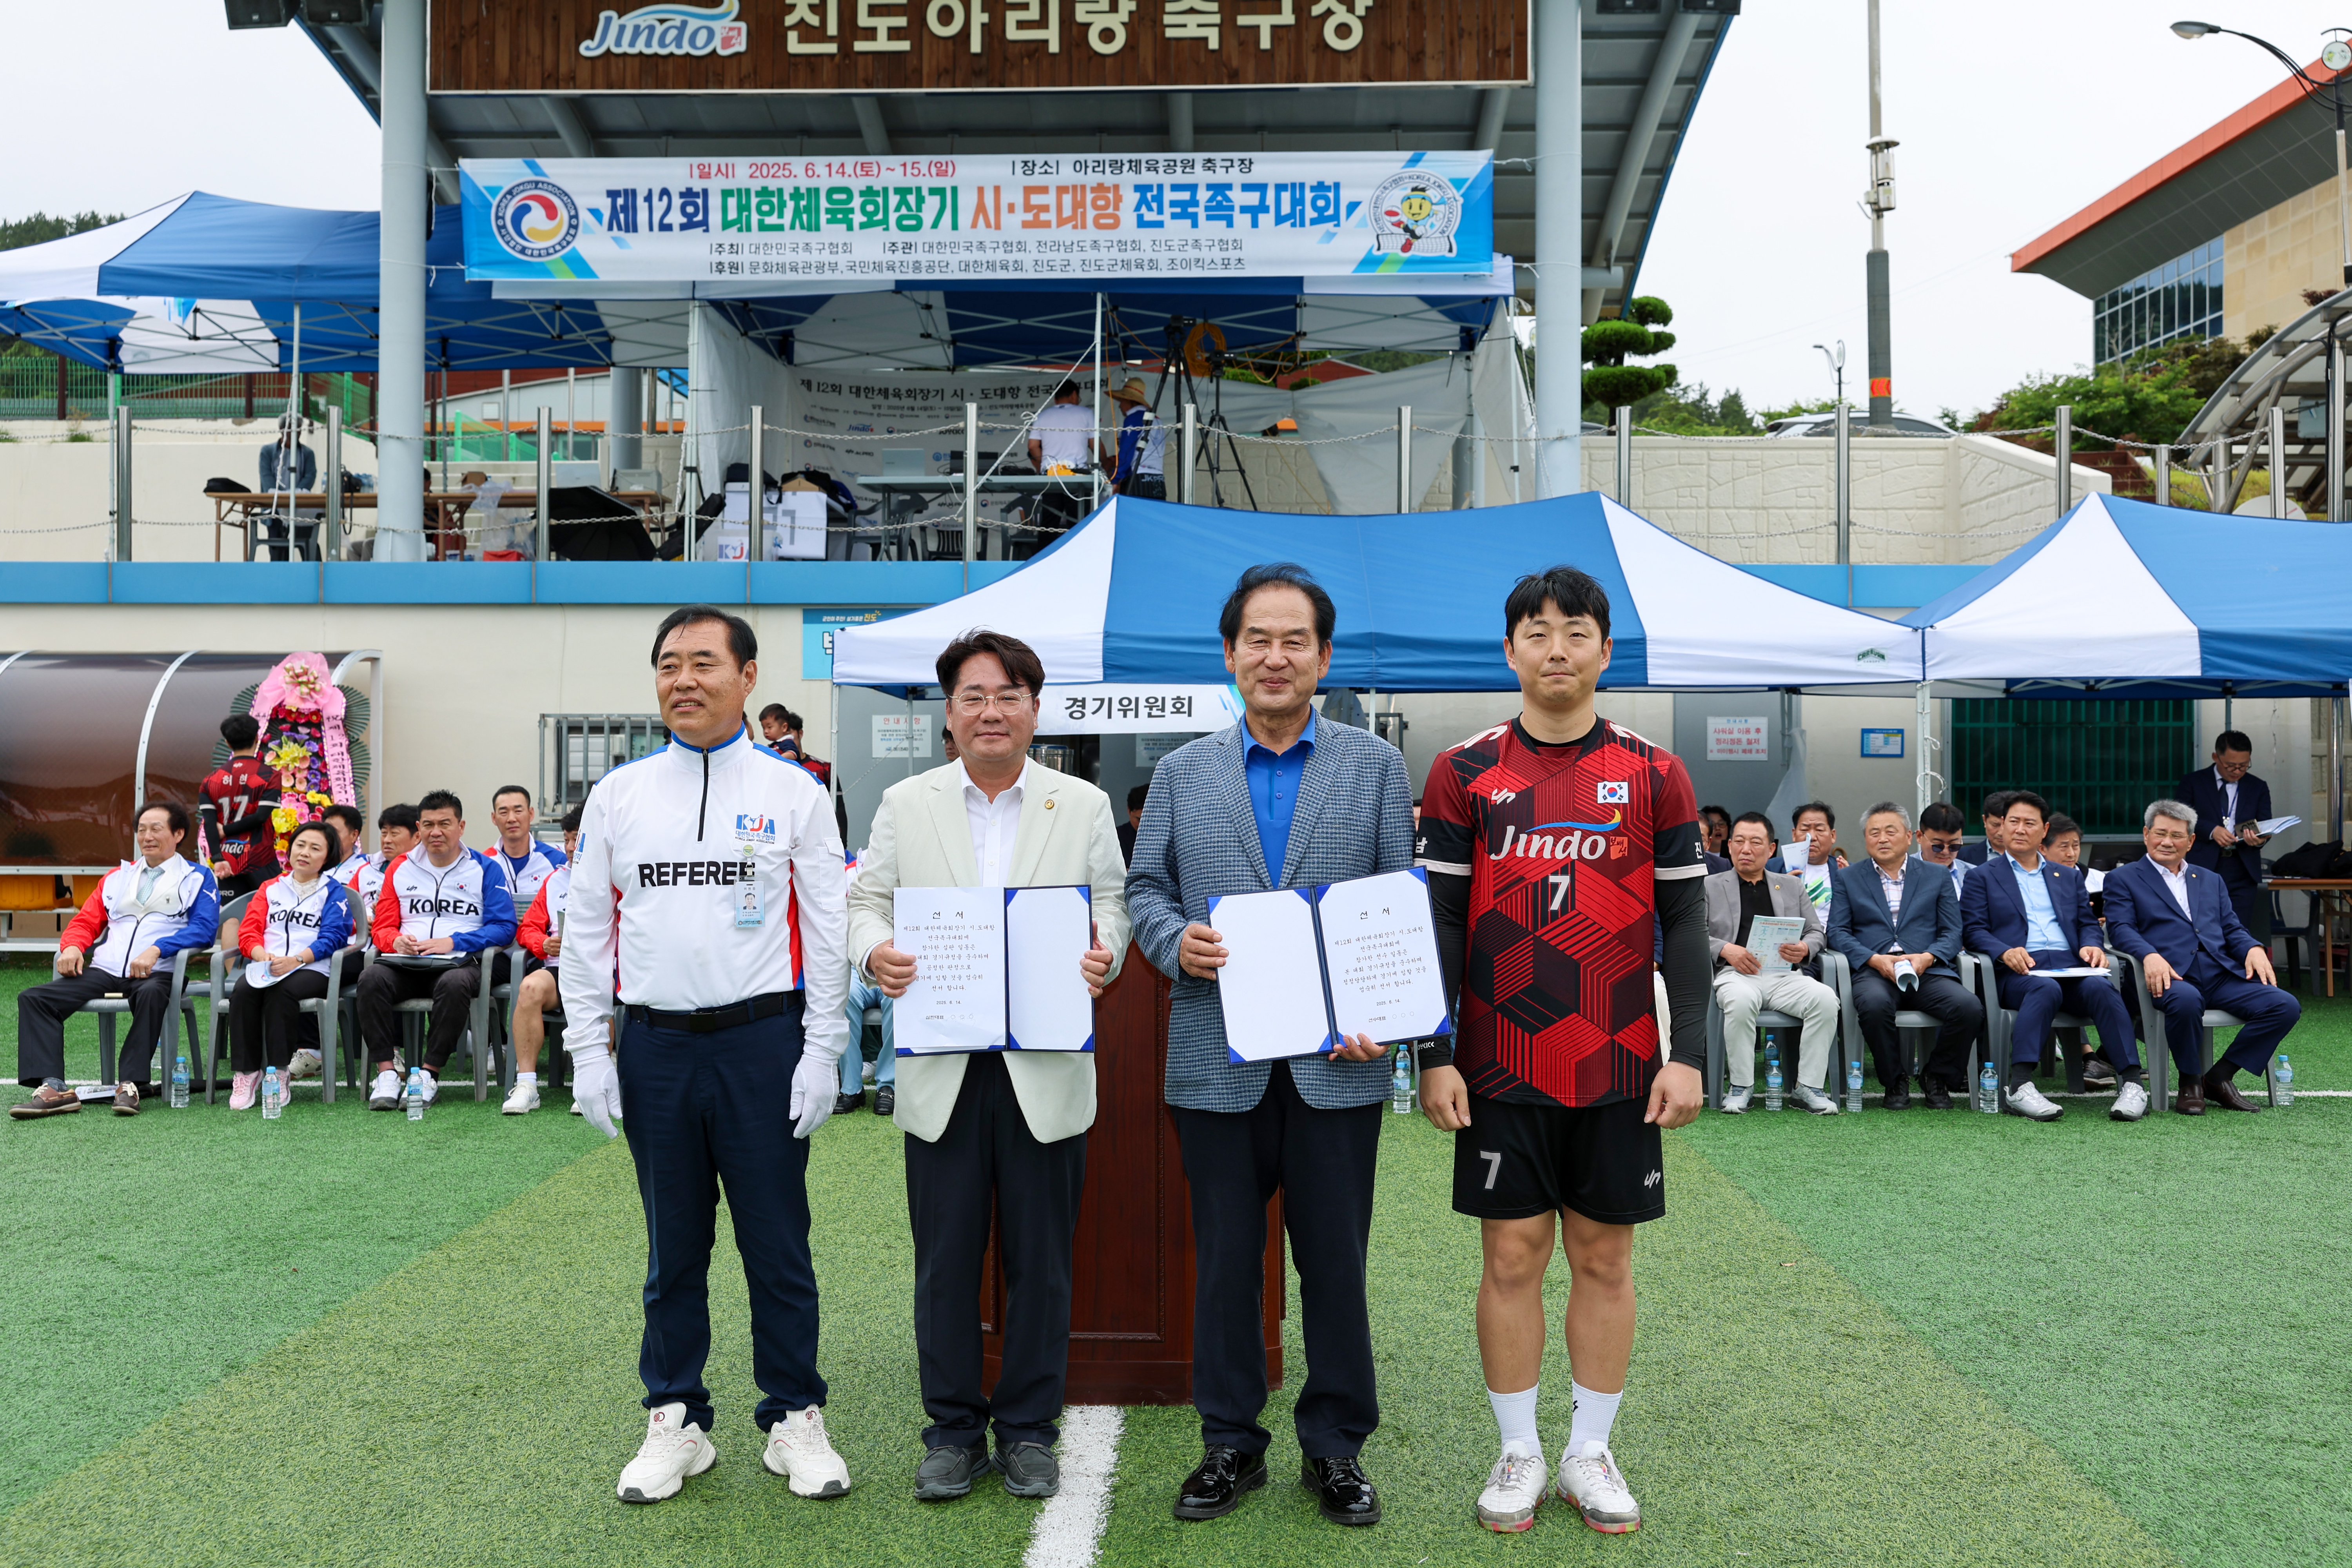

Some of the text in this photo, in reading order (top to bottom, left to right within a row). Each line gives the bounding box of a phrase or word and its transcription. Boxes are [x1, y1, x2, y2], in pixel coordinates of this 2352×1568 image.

[584, 15, 716, 51] Jindo
[785, 0, 1372, 54] 진도아리랑 축구장
[749, 162, 797, 178] 2025.
[1073, 158, 1196, 175] 아리랑체육공원
[1201, 158, 1254, 173] 축구장
[497, 182, 576, 217] KOREA JOKGU ASSOCIATION
[606, 181, 1341, 232] 제12회 대한체육회장기 시·도대항 전국족구대회
[749, 242, 853, 255] 대한민국족구협회
[923, 240, 1031, 254] 대한민국족구협회,
[1036, 240, 1145, 253] 전라남도족구협회,
[1151, 239, 1242, 252] 진도군족구협회
[749, 261, 843, 274] 문화체육관광부,
[846, 260, 953, 274] 국민체육진흥공단,
[959, 259, 1027, 273] 대한체육회,
[1032, 259, 1075, 273] 진도군,
[1080, 258, 1162, 272] 진도군체육회,
[1167, 257, 1245, 271] 조이킥스포츠
[800, 379, 812, 392] 제
[817, 382, 842, 396] 12회
[849, 385, 944, 401] 대한체육회장기
[719, 543, 749, 559] KJ
[864, 613, 877, 622] 진도
[1857, 649, 1885, 661] CARAVAN
[1064, 695, 1192, 720] 경기위원회
[218, 795, 249, 826] 17
[735, 830, 775, 842] 대한민국족구협회
[1490, 826, 1606, 860] Jindo
[1416, 837, 1428, 853] 남
[638, 861, 755, 887] REFEREE
[1549, 875, 1570, 911] 7
[409, 898, 479, 916] KOREA
[269, 910, 322, 928] KOREA
[1334, 938, 1352, 946] 제12회
[1356, 931, 1395, 943] 대한체육회장기
[1360, 940, 1400, 952] 전국족구대회에
[1356, 955, 1373, 963] 참가한
[1390, 949, 1408, 957] 일동은
[1367, 961, 1396, 971] 경기규정을
[1399, 956, 1422, 966] 준수하며
[1343, 975, 1377, 985] 정정당당하게
[1380, 971, 1397, 980] 경기에
[1359, 985, 1376, 993] 엄숙히
[1394, 979, 1413, 987] 합니다.
[1479, 1149, 1502, 1190] 7
